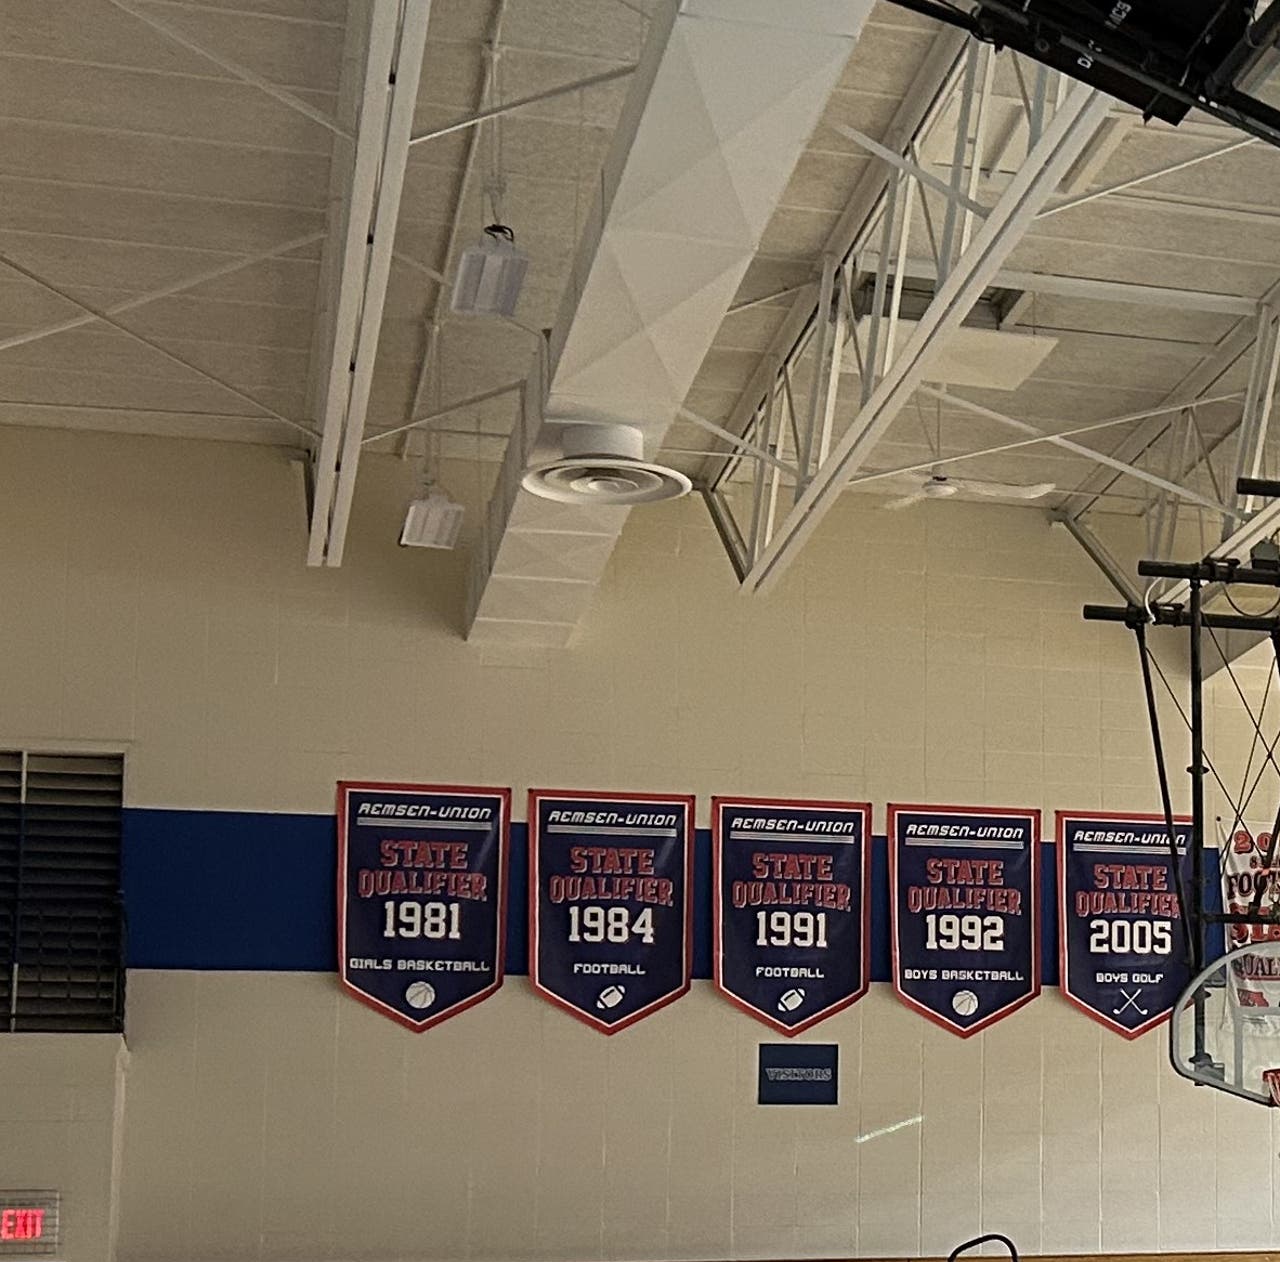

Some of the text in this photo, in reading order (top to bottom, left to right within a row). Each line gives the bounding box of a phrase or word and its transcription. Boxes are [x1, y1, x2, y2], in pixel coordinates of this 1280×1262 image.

[359, 803, 492, 820] REMSEN-UNION
[548, 810, 677, 826] REMSEN-UNION
[731, 818, 854, 834] REMSEN-UNION
[906, 824, 1024, 839] REMSEN-UNION
[380, 840, 468, 868] STATE
[570, 846, 654, 875] STATE
[752, 853, 833, 880] STATE
[358, 870, 488, 901] QUALIFIER
[926, 858, 1004, 886] STATE
[1094, 864, 1168, 891] STATE
[550, 876, 674, 907] QUALIFIER
[732, 881, 851, 912] QUALIFIER
[908, 886, 1022, 916] QUALIFIER
[384, 900, 460, 940] 1981
[568, 905, 654, 944] 1984
[756, 910, 828, 948] 1991
[926, 914, 1004, 951] 1992
[1090, 920, 1171, 954] 2005
[350, 958, 490, 972] GIRLS BASKETBALL
[574, 963, 646, 975] FOOTBALL
[756, 966, 824, 978] FOOTBALL
[905, 969, 1024, 981] BOYS BASKETBALL
[1096, 973, 1164, 984] BOYS GOLF
[766, 1068, 832, 1081] VISITORS
[1, 1209, 45, 1239] EXIT
